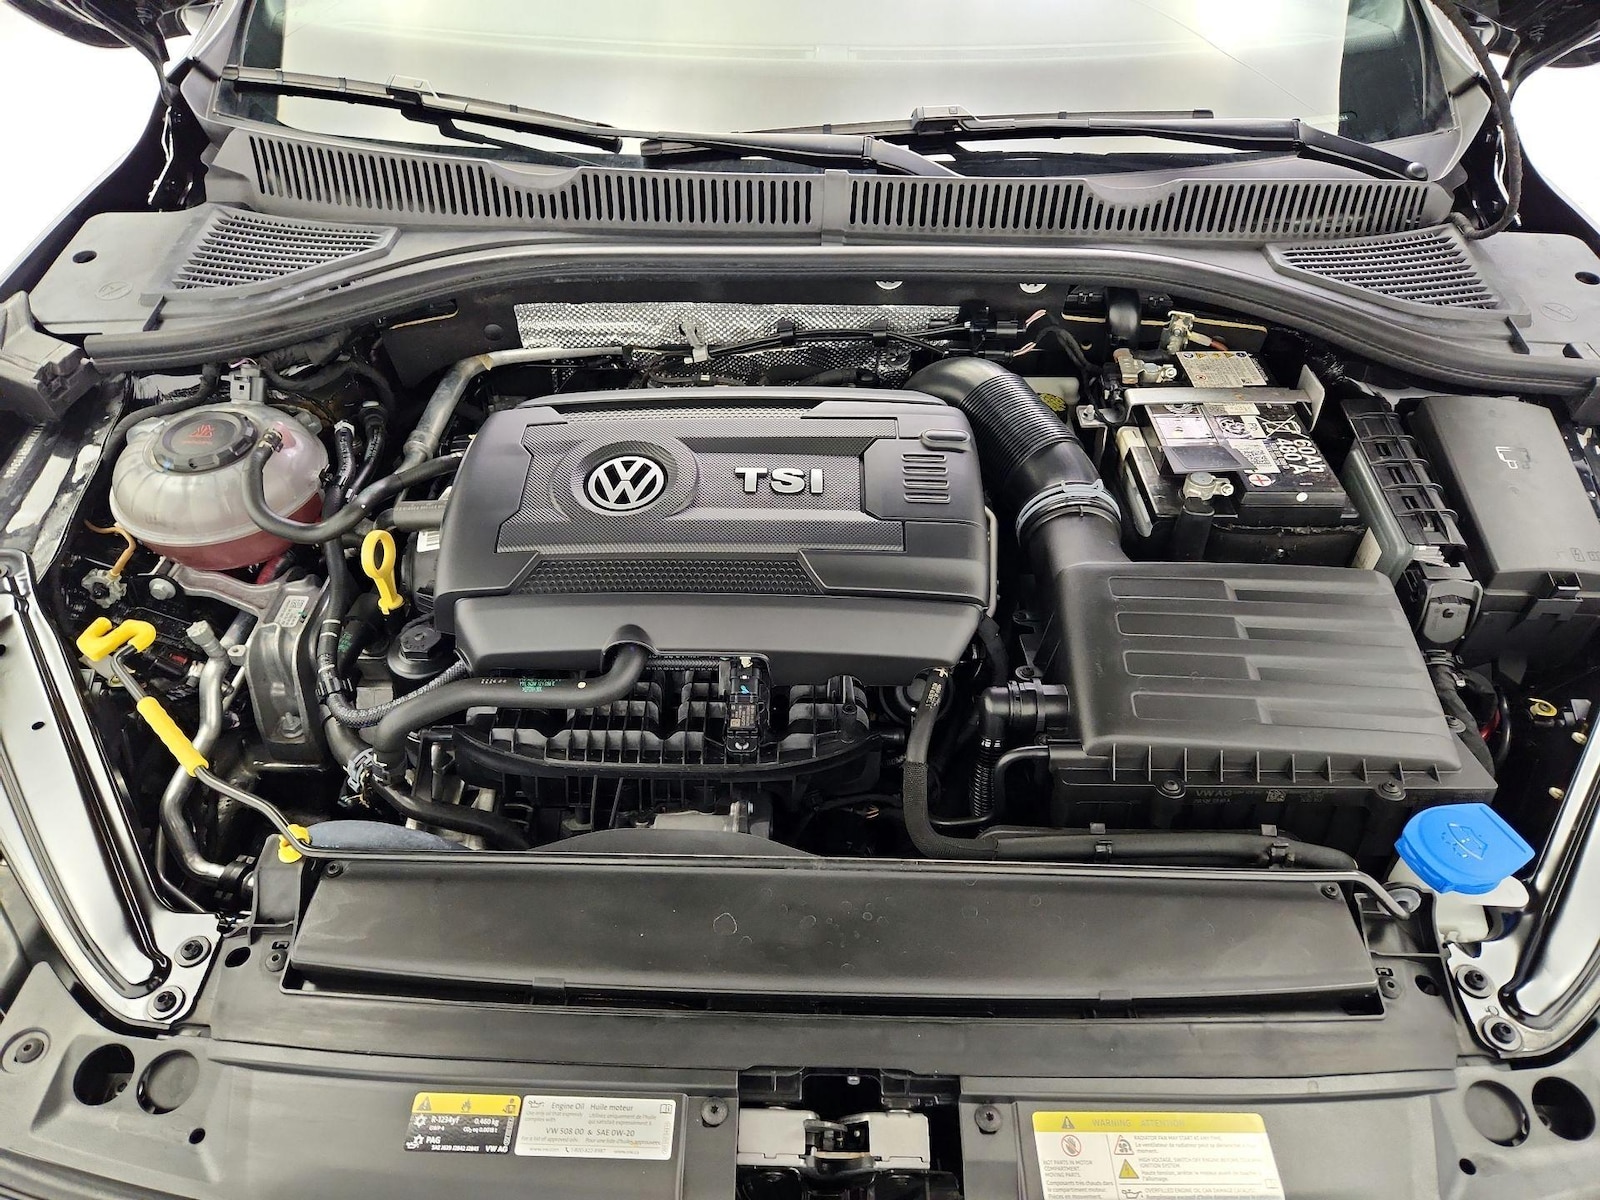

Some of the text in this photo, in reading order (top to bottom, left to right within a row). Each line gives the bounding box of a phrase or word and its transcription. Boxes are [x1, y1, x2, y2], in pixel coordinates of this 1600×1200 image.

[1277, 438, 1303, 461] 480
[1294, 440, 1326, 473] 60Ah
[1289, 463, 1310, 474] A
[587, 455, 664, 511] VW
[735, 467, 823, 494] TSI
[551, 1102, 574, 1111] Engine
[590, 1103, 608, 1111] Huile
[609, 1104, 634, 1112] moteur
[431, 1115, 460, 1126] R-1234yf
[491, 1118, 500, 1127] kg
[1092, 1119, 1132, 1127] WARNING
[560, 1127, 573, 1135] 508
[596, 1128, 610, 1137] SAE
[611, 1129, 636, 1137] 0W-20
[426, 1135, 441, 1144] PAG
[485, 1145, 508, 1153] VW AG
